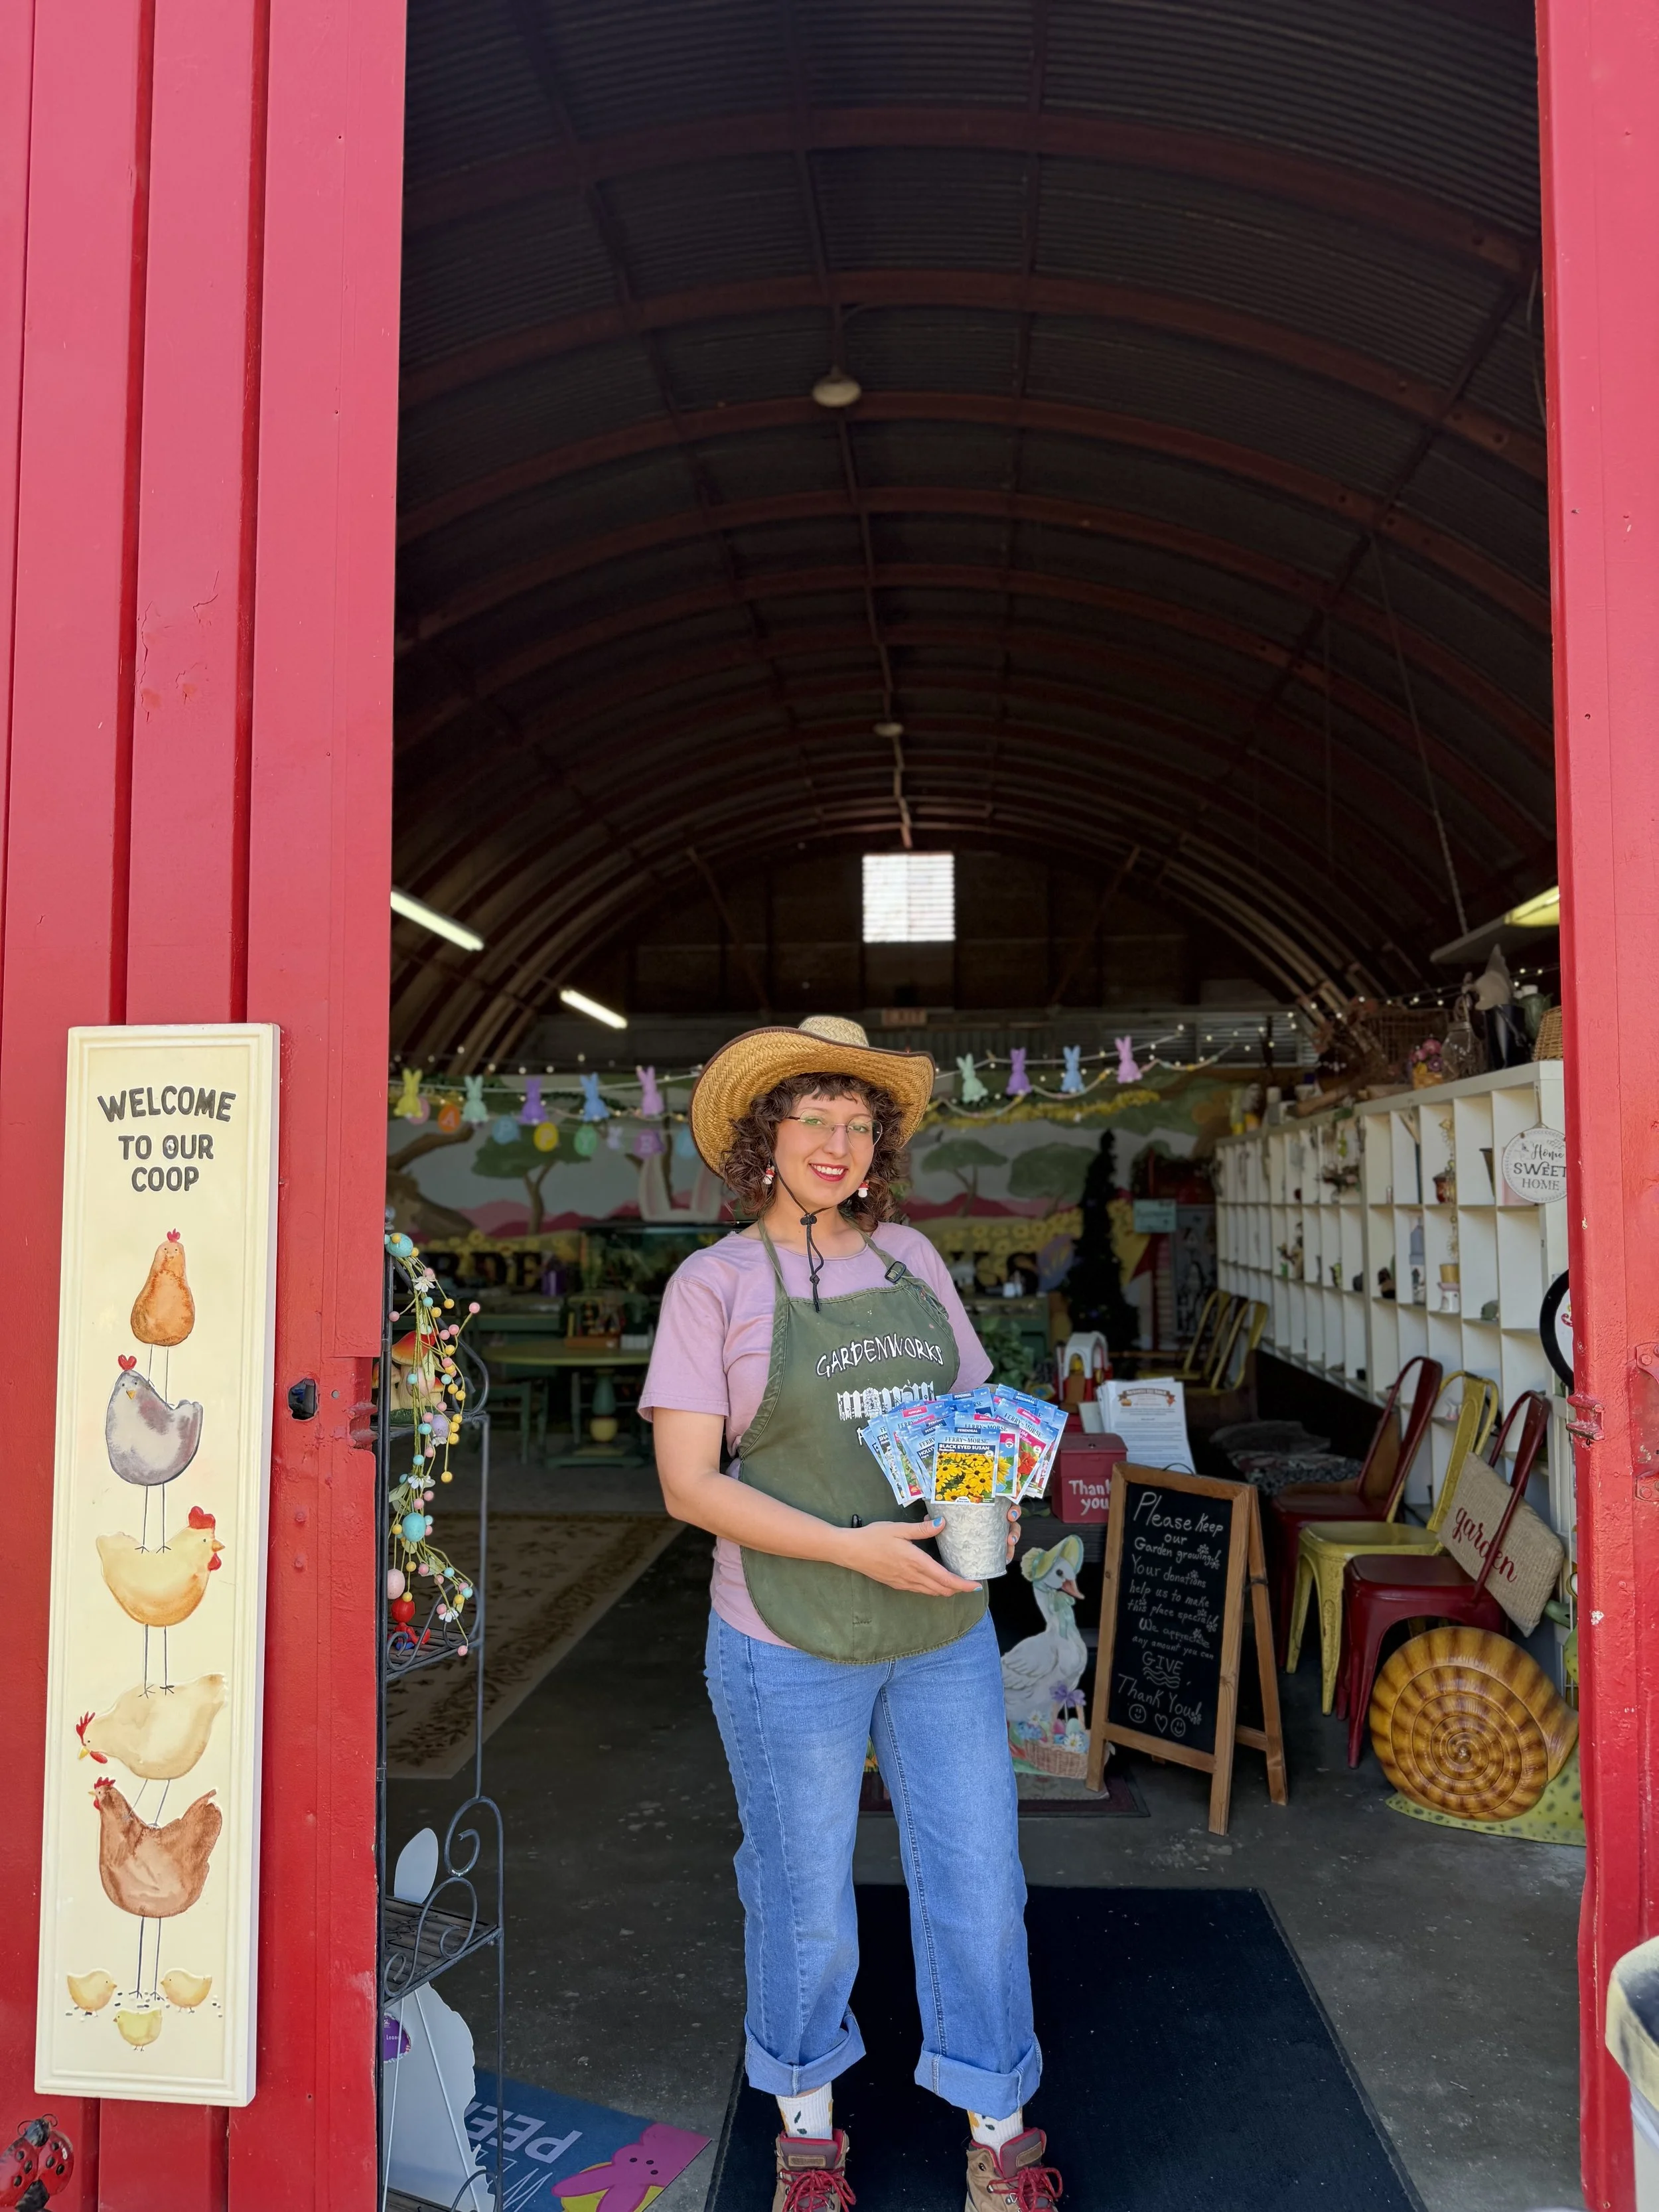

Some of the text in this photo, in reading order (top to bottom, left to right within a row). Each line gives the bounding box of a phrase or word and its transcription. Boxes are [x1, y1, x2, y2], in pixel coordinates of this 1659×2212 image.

[97, 1086, 236, 1122] WELCOME
[118, 1134, 214, 1160] TO OUR
[1531, 1143, 1564, 1160] Home
[131, 1166, 199, 1192] COOP
[1514, 1161, 1566, 1177] SWEET
[1522, 1178, 1559, 1191] HOME
[816, 1333, 944, 1378] GARDENWORKS
[1068, 1479, 1112, 1495] Thank
[1080, 1497, 1110, 1516] you
[1133, 1492, 1224, 1537] Please Keep
[1134, 1537, 1173, 1557] Garden
[1164, 1534, 1187, 1545] our
[1132, 1554, 1206, 1588] Your donations
[1129, 1579, 1151, 1599] help
[1155, 1589, 1168, 1598] us
[1171, 1589, 1181, 1601] to
[1127, 1599, 1147, 1612] this
[1149, 1603, 1174, 1617] place
[1139, 1617, 1159, 1632] We
[1132, 1635, 1148, 1649] any
[1151, 1640, 1181, 1652] amount
[1183, 1647, 1198, 1657] you
[1142, 1651, 1184, 1675] GIVE
[1118, 1673, 1164, 1708] Thank
